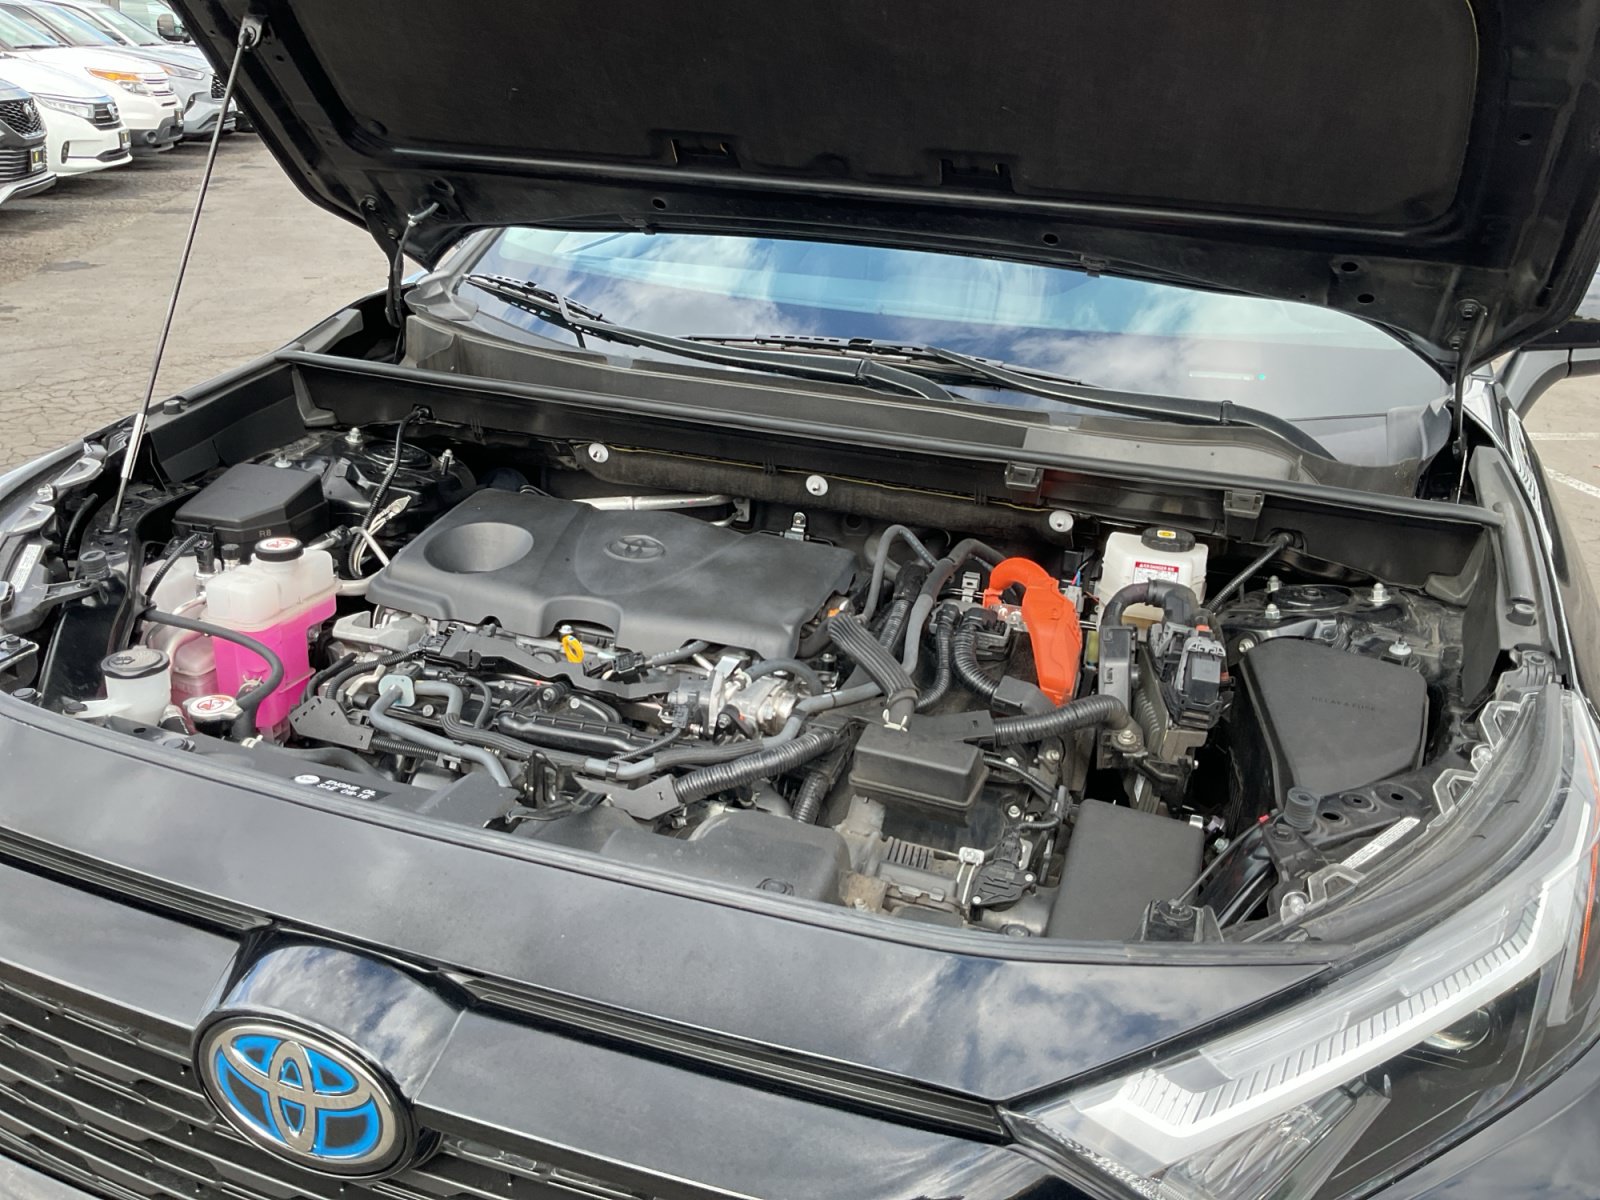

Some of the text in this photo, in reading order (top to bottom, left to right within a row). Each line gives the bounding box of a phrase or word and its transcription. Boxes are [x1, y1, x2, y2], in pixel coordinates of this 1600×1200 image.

[259, 529, 272, 538] R8
[317, 783, 338, 791] SAE
[325, 780, 377, 797] ENGINE OIL
